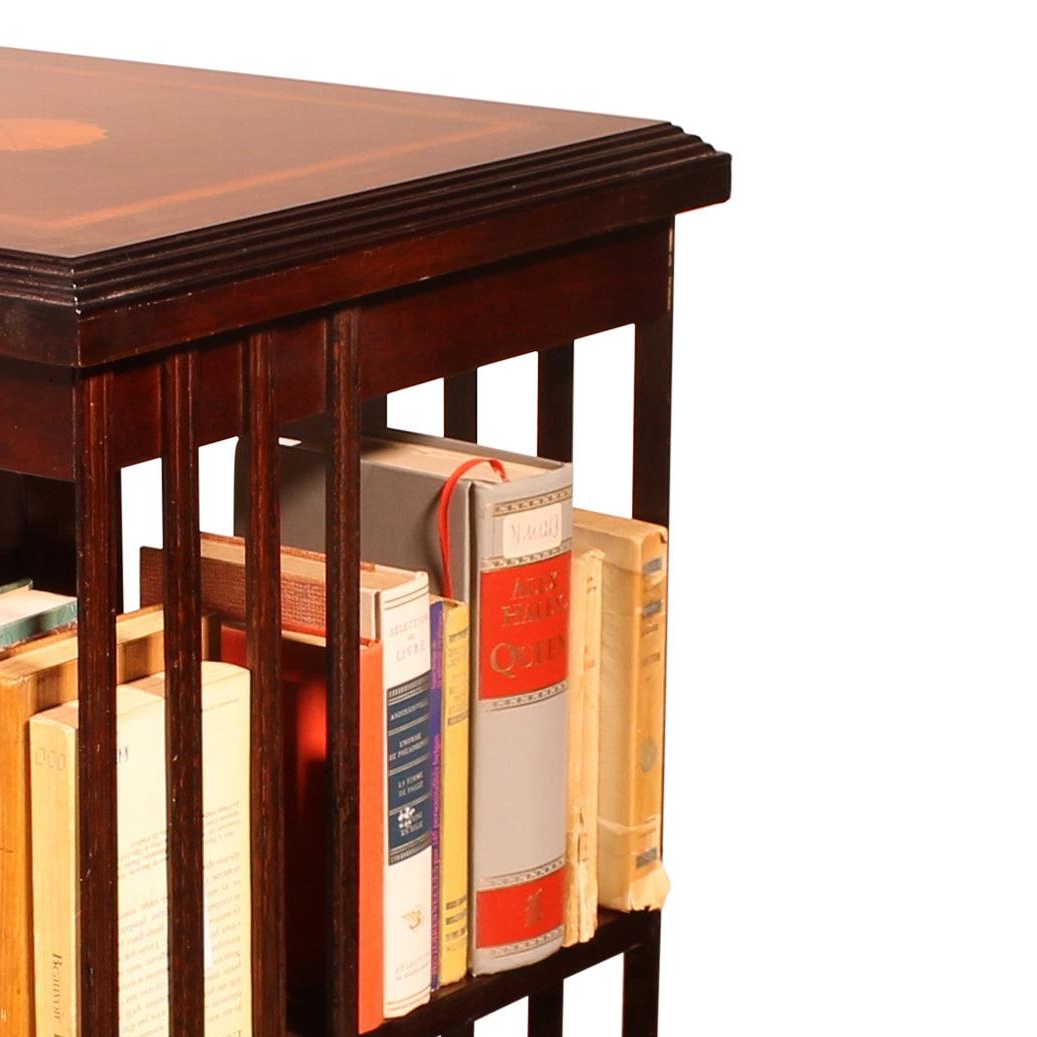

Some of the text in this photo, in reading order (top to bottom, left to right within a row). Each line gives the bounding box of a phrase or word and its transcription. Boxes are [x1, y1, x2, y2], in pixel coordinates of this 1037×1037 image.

[510, 571, 558, 600] ALEX
[500, 594, 568, 627] HALEY
[490, 635, 566, 678] QUEEN
